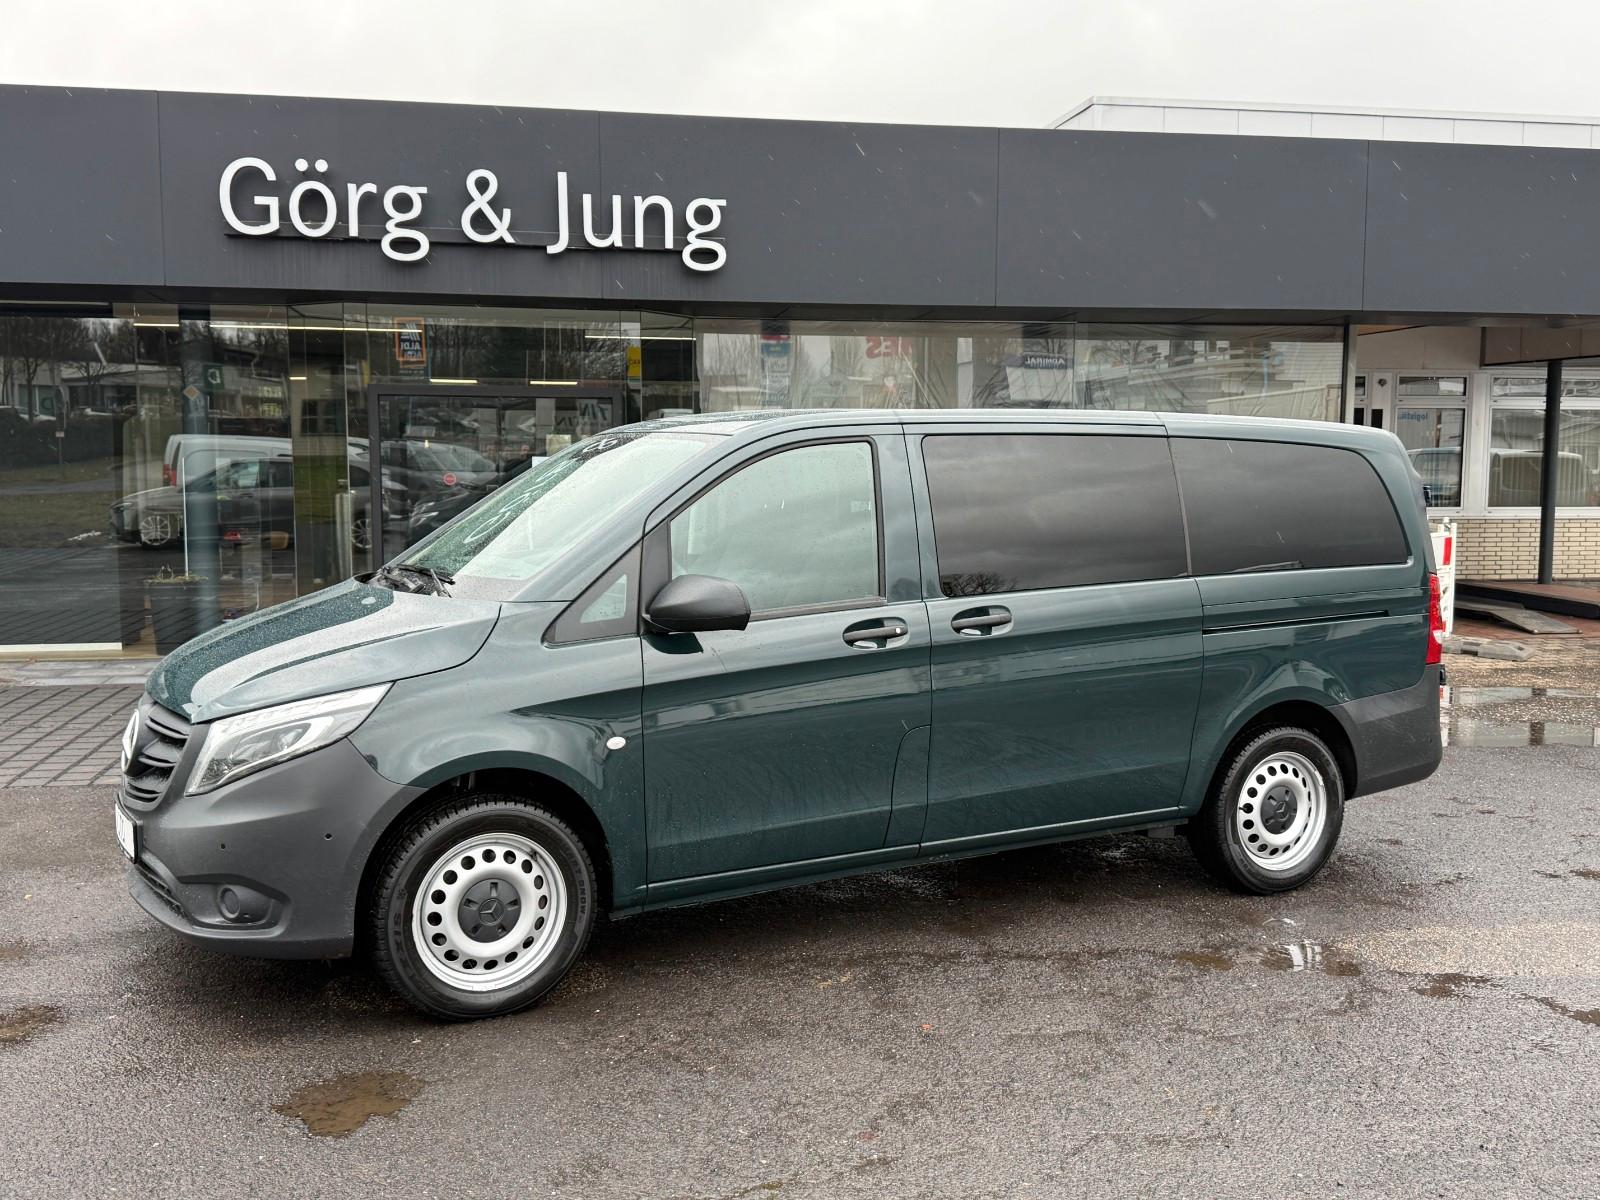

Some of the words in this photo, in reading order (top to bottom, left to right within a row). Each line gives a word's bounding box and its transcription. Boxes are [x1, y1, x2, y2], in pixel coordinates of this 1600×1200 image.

[219, 157, 430, 262] Görg
[461, 168, 516, 244] &
[546, 171, 728, 272] Jung
